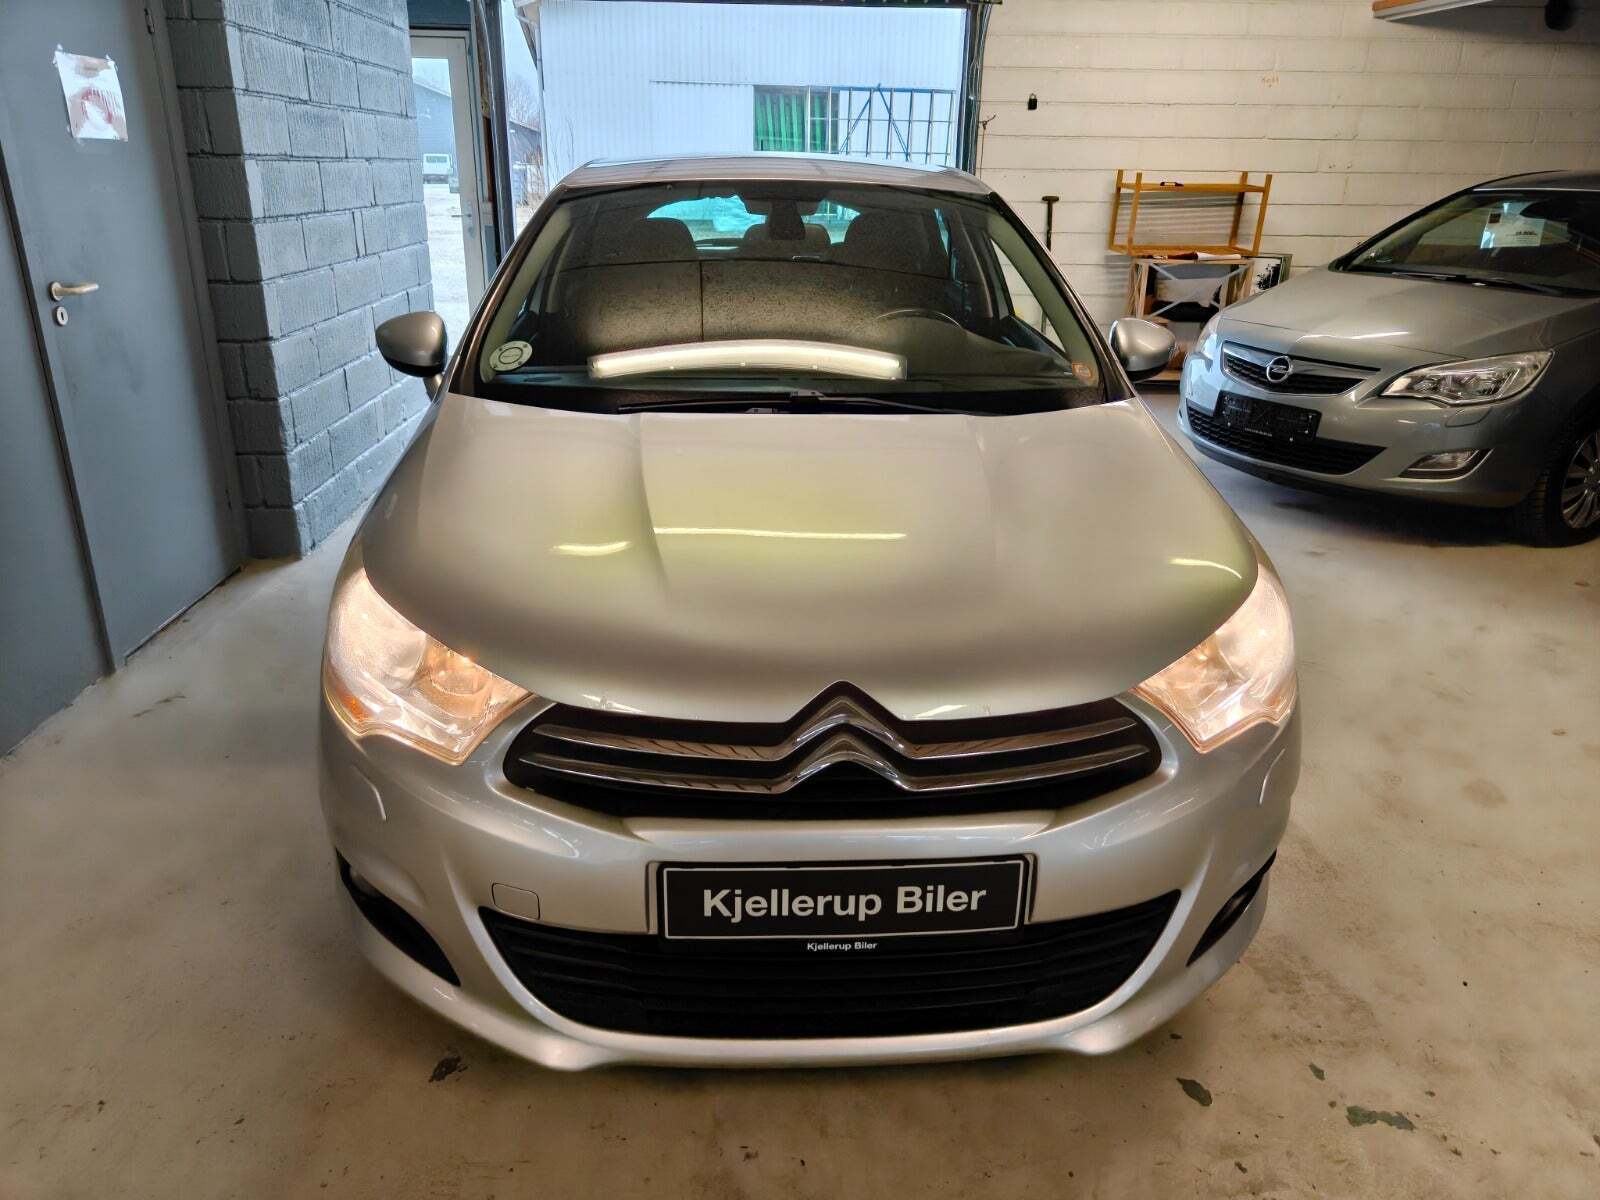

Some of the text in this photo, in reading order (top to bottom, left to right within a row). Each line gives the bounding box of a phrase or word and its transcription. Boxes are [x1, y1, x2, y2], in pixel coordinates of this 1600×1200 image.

[703, 884, 987, 923] Kjellerup Biler
[807, 941, 878, 952] Kjellerup Biler
